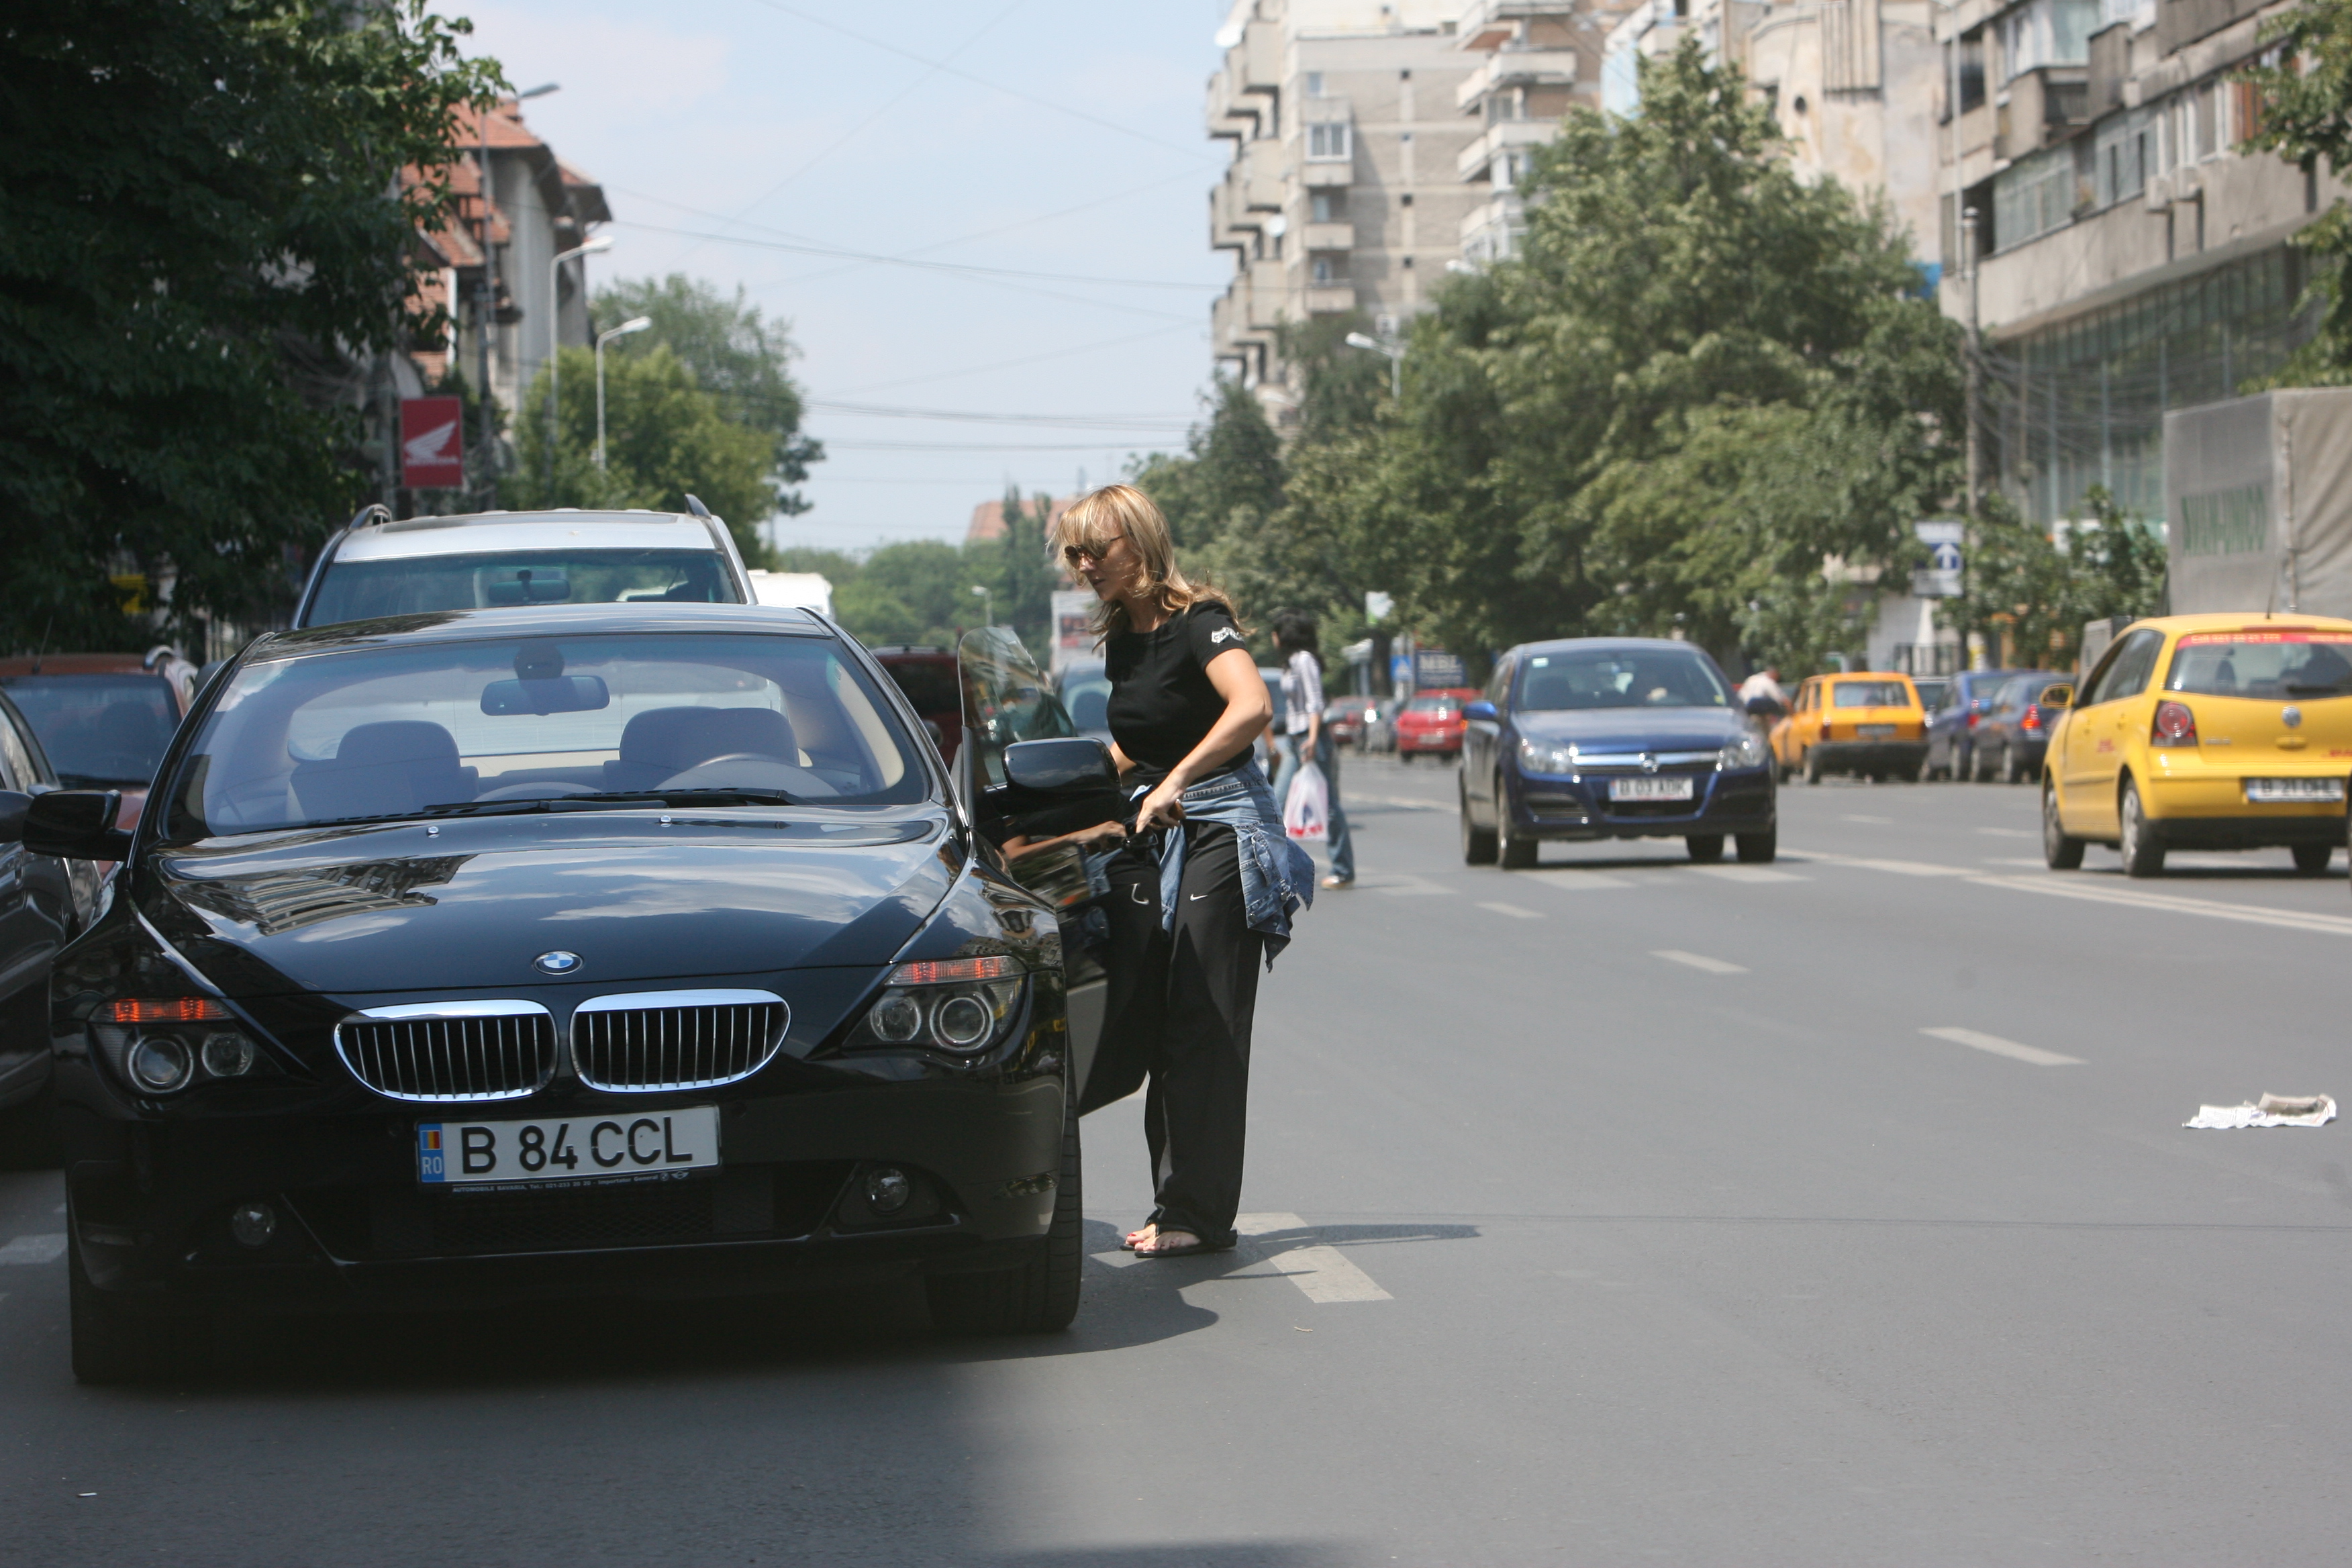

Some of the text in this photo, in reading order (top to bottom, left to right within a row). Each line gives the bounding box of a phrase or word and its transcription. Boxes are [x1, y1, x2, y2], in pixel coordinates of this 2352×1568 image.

[460, 1116, 693, 1174] B 84 CCL
[422, 1156, 442, 1175] RO
